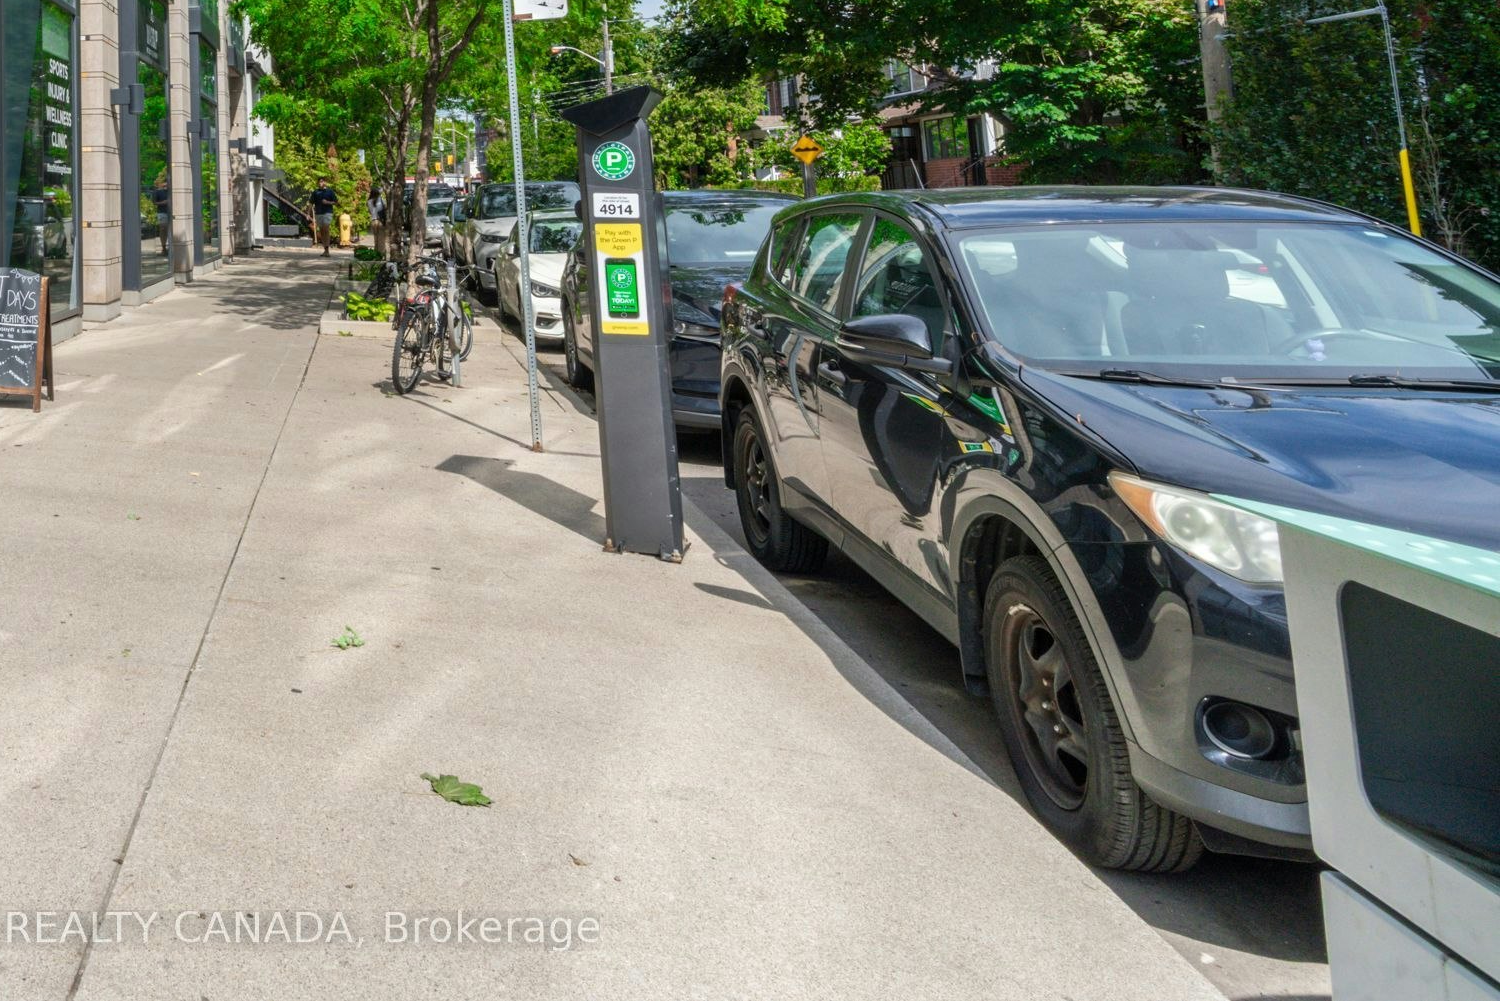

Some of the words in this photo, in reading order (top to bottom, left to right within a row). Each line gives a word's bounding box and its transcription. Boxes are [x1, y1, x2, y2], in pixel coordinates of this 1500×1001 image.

[49, 59, 69, 80] SPORTS
[47, 81, 66, 102] INJURY
[46, 105, 72, 127] WELLNESS
[51, 131, 68, 149] CLINIC
[606, 152, 622, 167] P
[600, 204, 633, 215] 4914
[604, 229, 616, 237] Pay
[6, 289, 37, 311] DAYS
